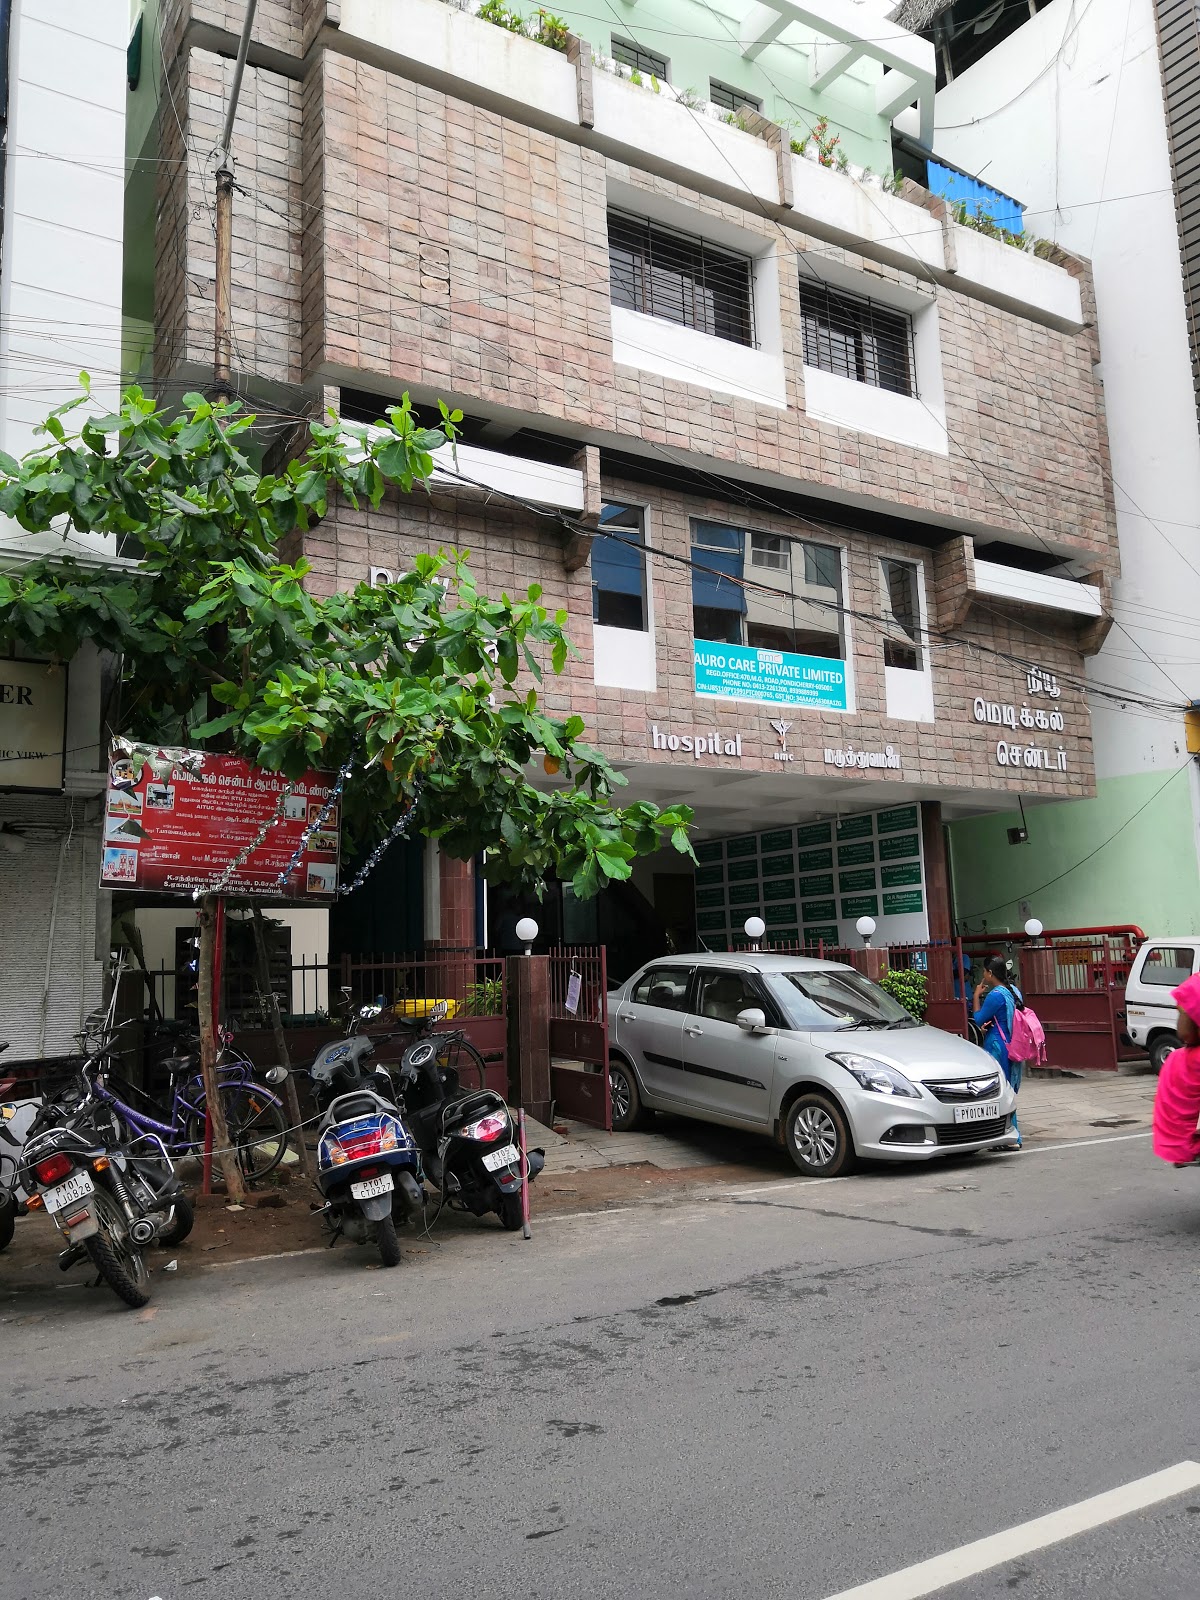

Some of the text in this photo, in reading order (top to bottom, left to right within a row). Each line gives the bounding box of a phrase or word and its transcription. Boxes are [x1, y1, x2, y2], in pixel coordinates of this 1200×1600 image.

[694, 652, 843, 684] AURO CARE PRIVATE LIMITED
[722, 678, 742, 687] PHONE
[973, 697, 1065, 732] மெடிக்கல்
[652, 725, 742, 759] hospital
[774, 752, 794, 762] nmc
[824, 744, 901, 770] மருத்துவமனை
[996, 741, 1067, 771] சென்டர்
[55, 1177, 80, 1197] PY01
[55, 1182, 92, 1209] AJ0828
[360, 1182, 391, 1198] CT0227
[362, 1177, 383, 1190] PY01
